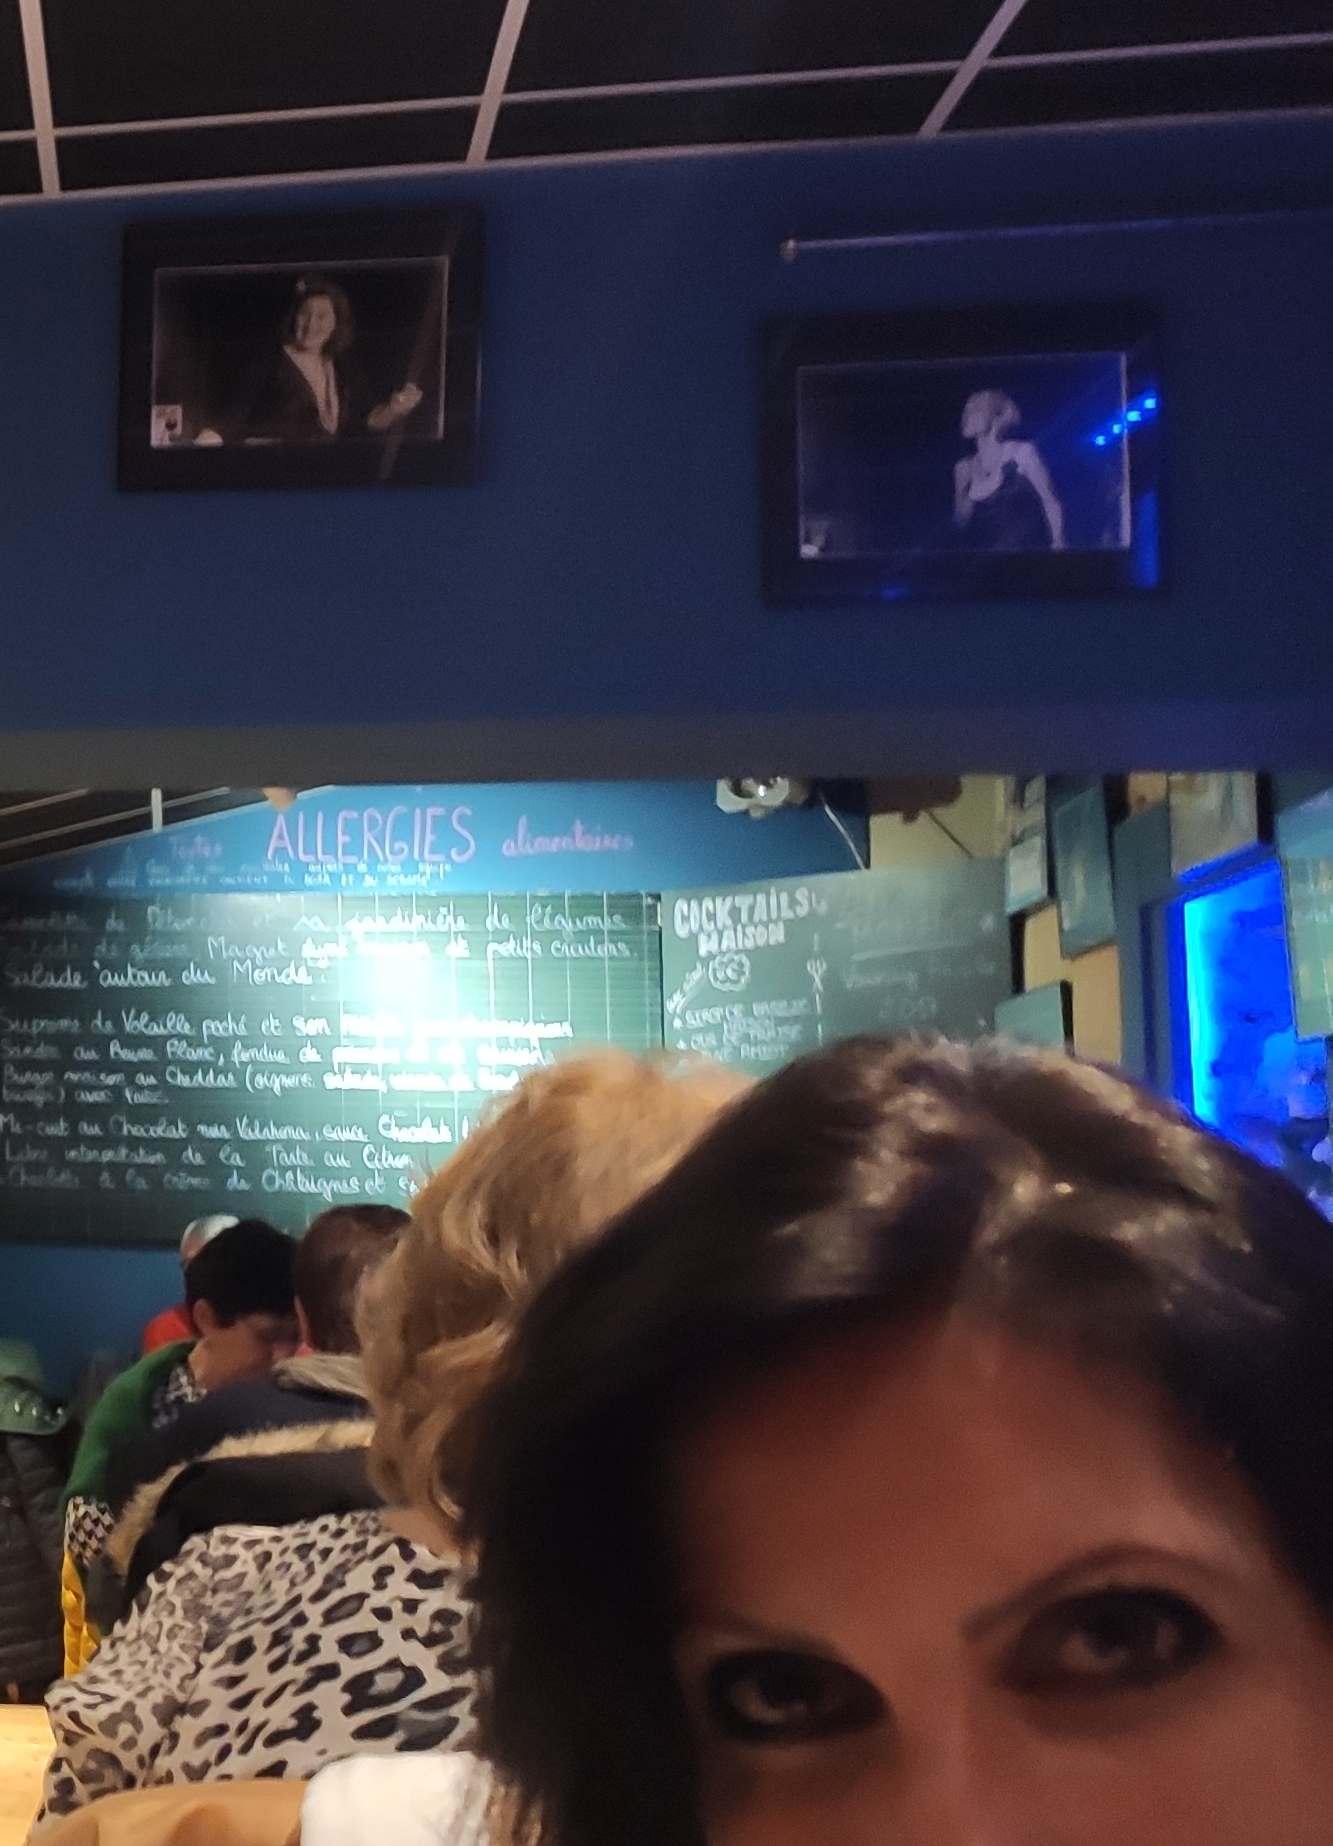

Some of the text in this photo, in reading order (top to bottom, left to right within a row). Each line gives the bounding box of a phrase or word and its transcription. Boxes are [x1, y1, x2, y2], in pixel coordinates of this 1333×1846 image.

[266, 805, 476, 864] ALLERGIES
[673, 887, 810, 939] COCKTAILS
[697, 920, 786, 958] MAISON
[181, 960, 216, 986] du
[121, 1007, 199, 1037] Volaille
